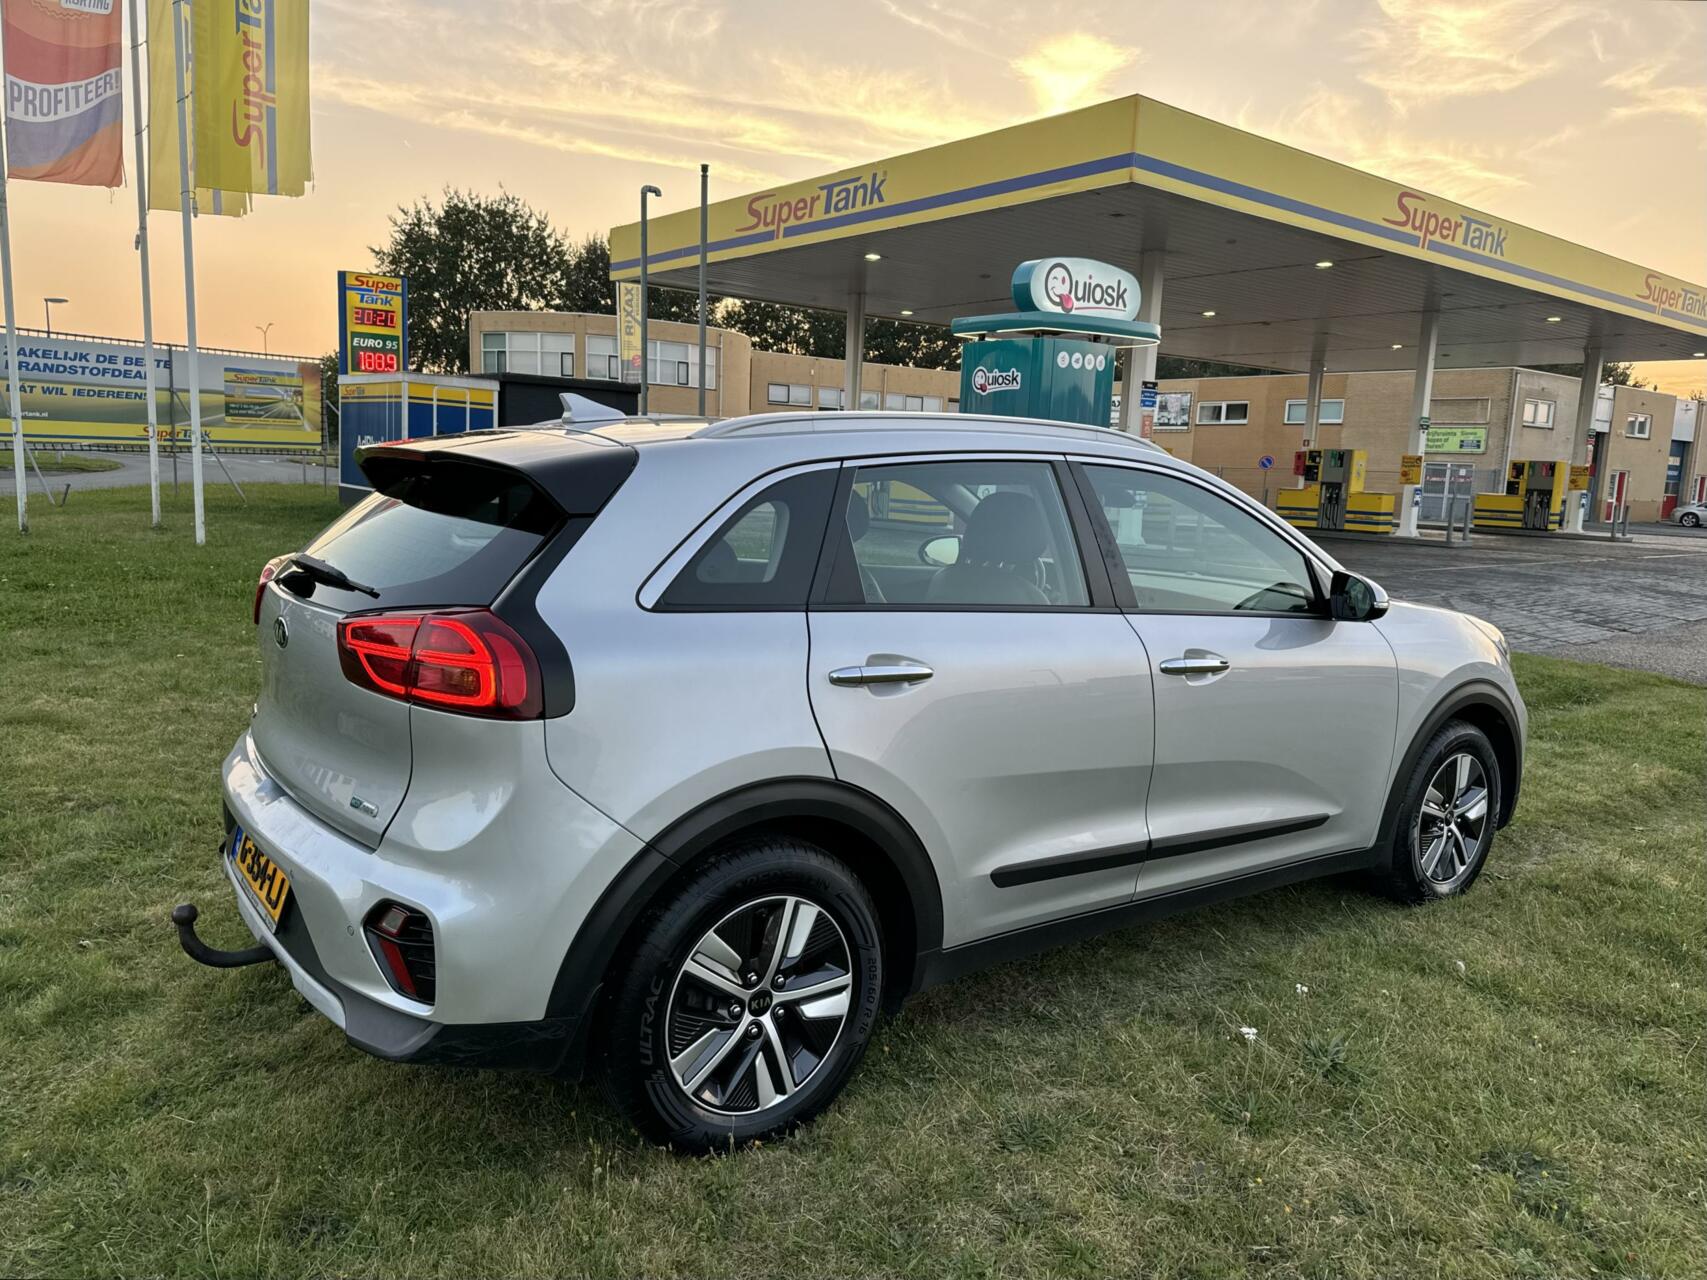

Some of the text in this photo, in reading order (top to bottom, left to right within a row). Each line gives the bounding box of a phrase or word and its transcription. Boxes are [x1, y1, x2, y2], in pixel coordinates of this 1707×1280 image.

[9, 70, 120, 118] PROFITEER!
[735, 172, 887, 239] SuperTank
[1382, 191, 1508, 257] SuperTank
[354, 275, 400, 294] Super
[1044, 262, 1128, 313] Quiosk
[354, 293, 394, 307] Tank
[353, 337, 398, 350] EURO 95
[96, 354, 118, 365] DE
[123, 356, 173, 369] BETE
[973, 368, 1019, 392] Quiosk
[41, 386, 67, 396] WIL
[751, 996, 771, 1010] KIA
[639, 975, 665, 1065] ULTRAC
